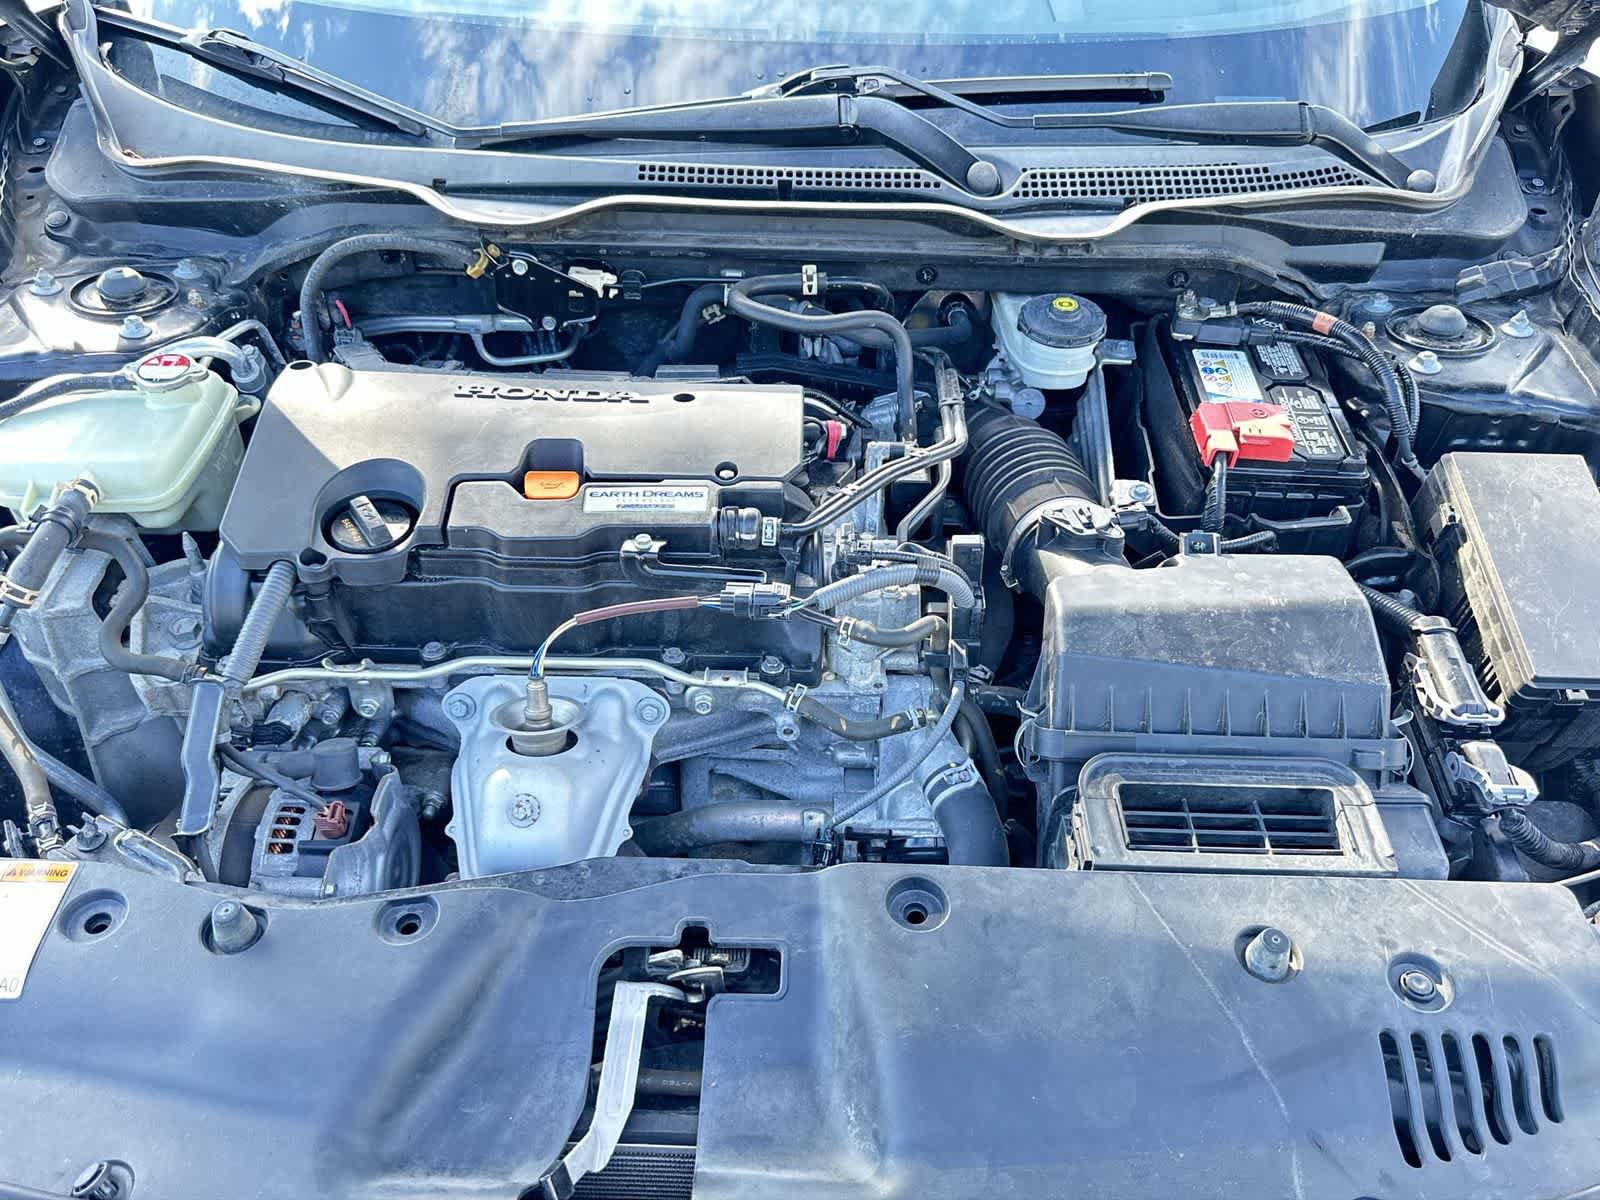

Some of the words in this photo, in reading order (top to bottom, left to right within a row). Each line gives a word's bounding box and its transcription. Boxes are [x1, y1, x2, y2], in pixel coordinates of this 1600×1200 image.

[453, 384, 650, 404] HONDA
[642, 490, 704, 498] DREAMS
[19, 869, 69, 877] WARNING
